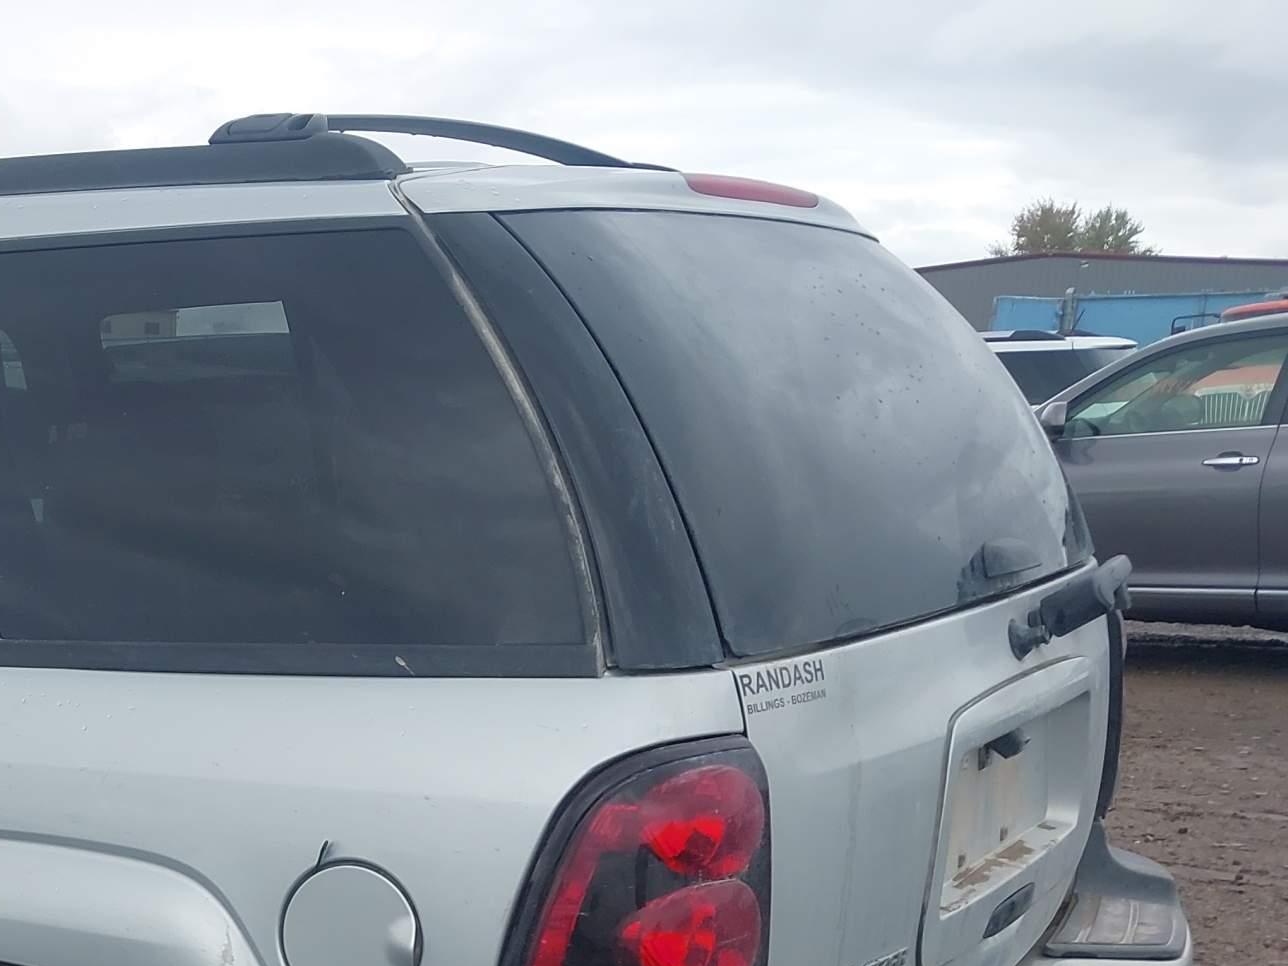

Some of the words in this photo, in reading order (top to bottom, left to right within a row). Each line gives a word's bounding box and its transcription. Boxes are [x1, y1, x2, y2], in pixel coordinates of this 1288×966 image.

[739, 659, 825, 697] RANDASH
[747, 697, 785, 714] BILLINGS
[791, 688, 826, 704] BOZEMAN
